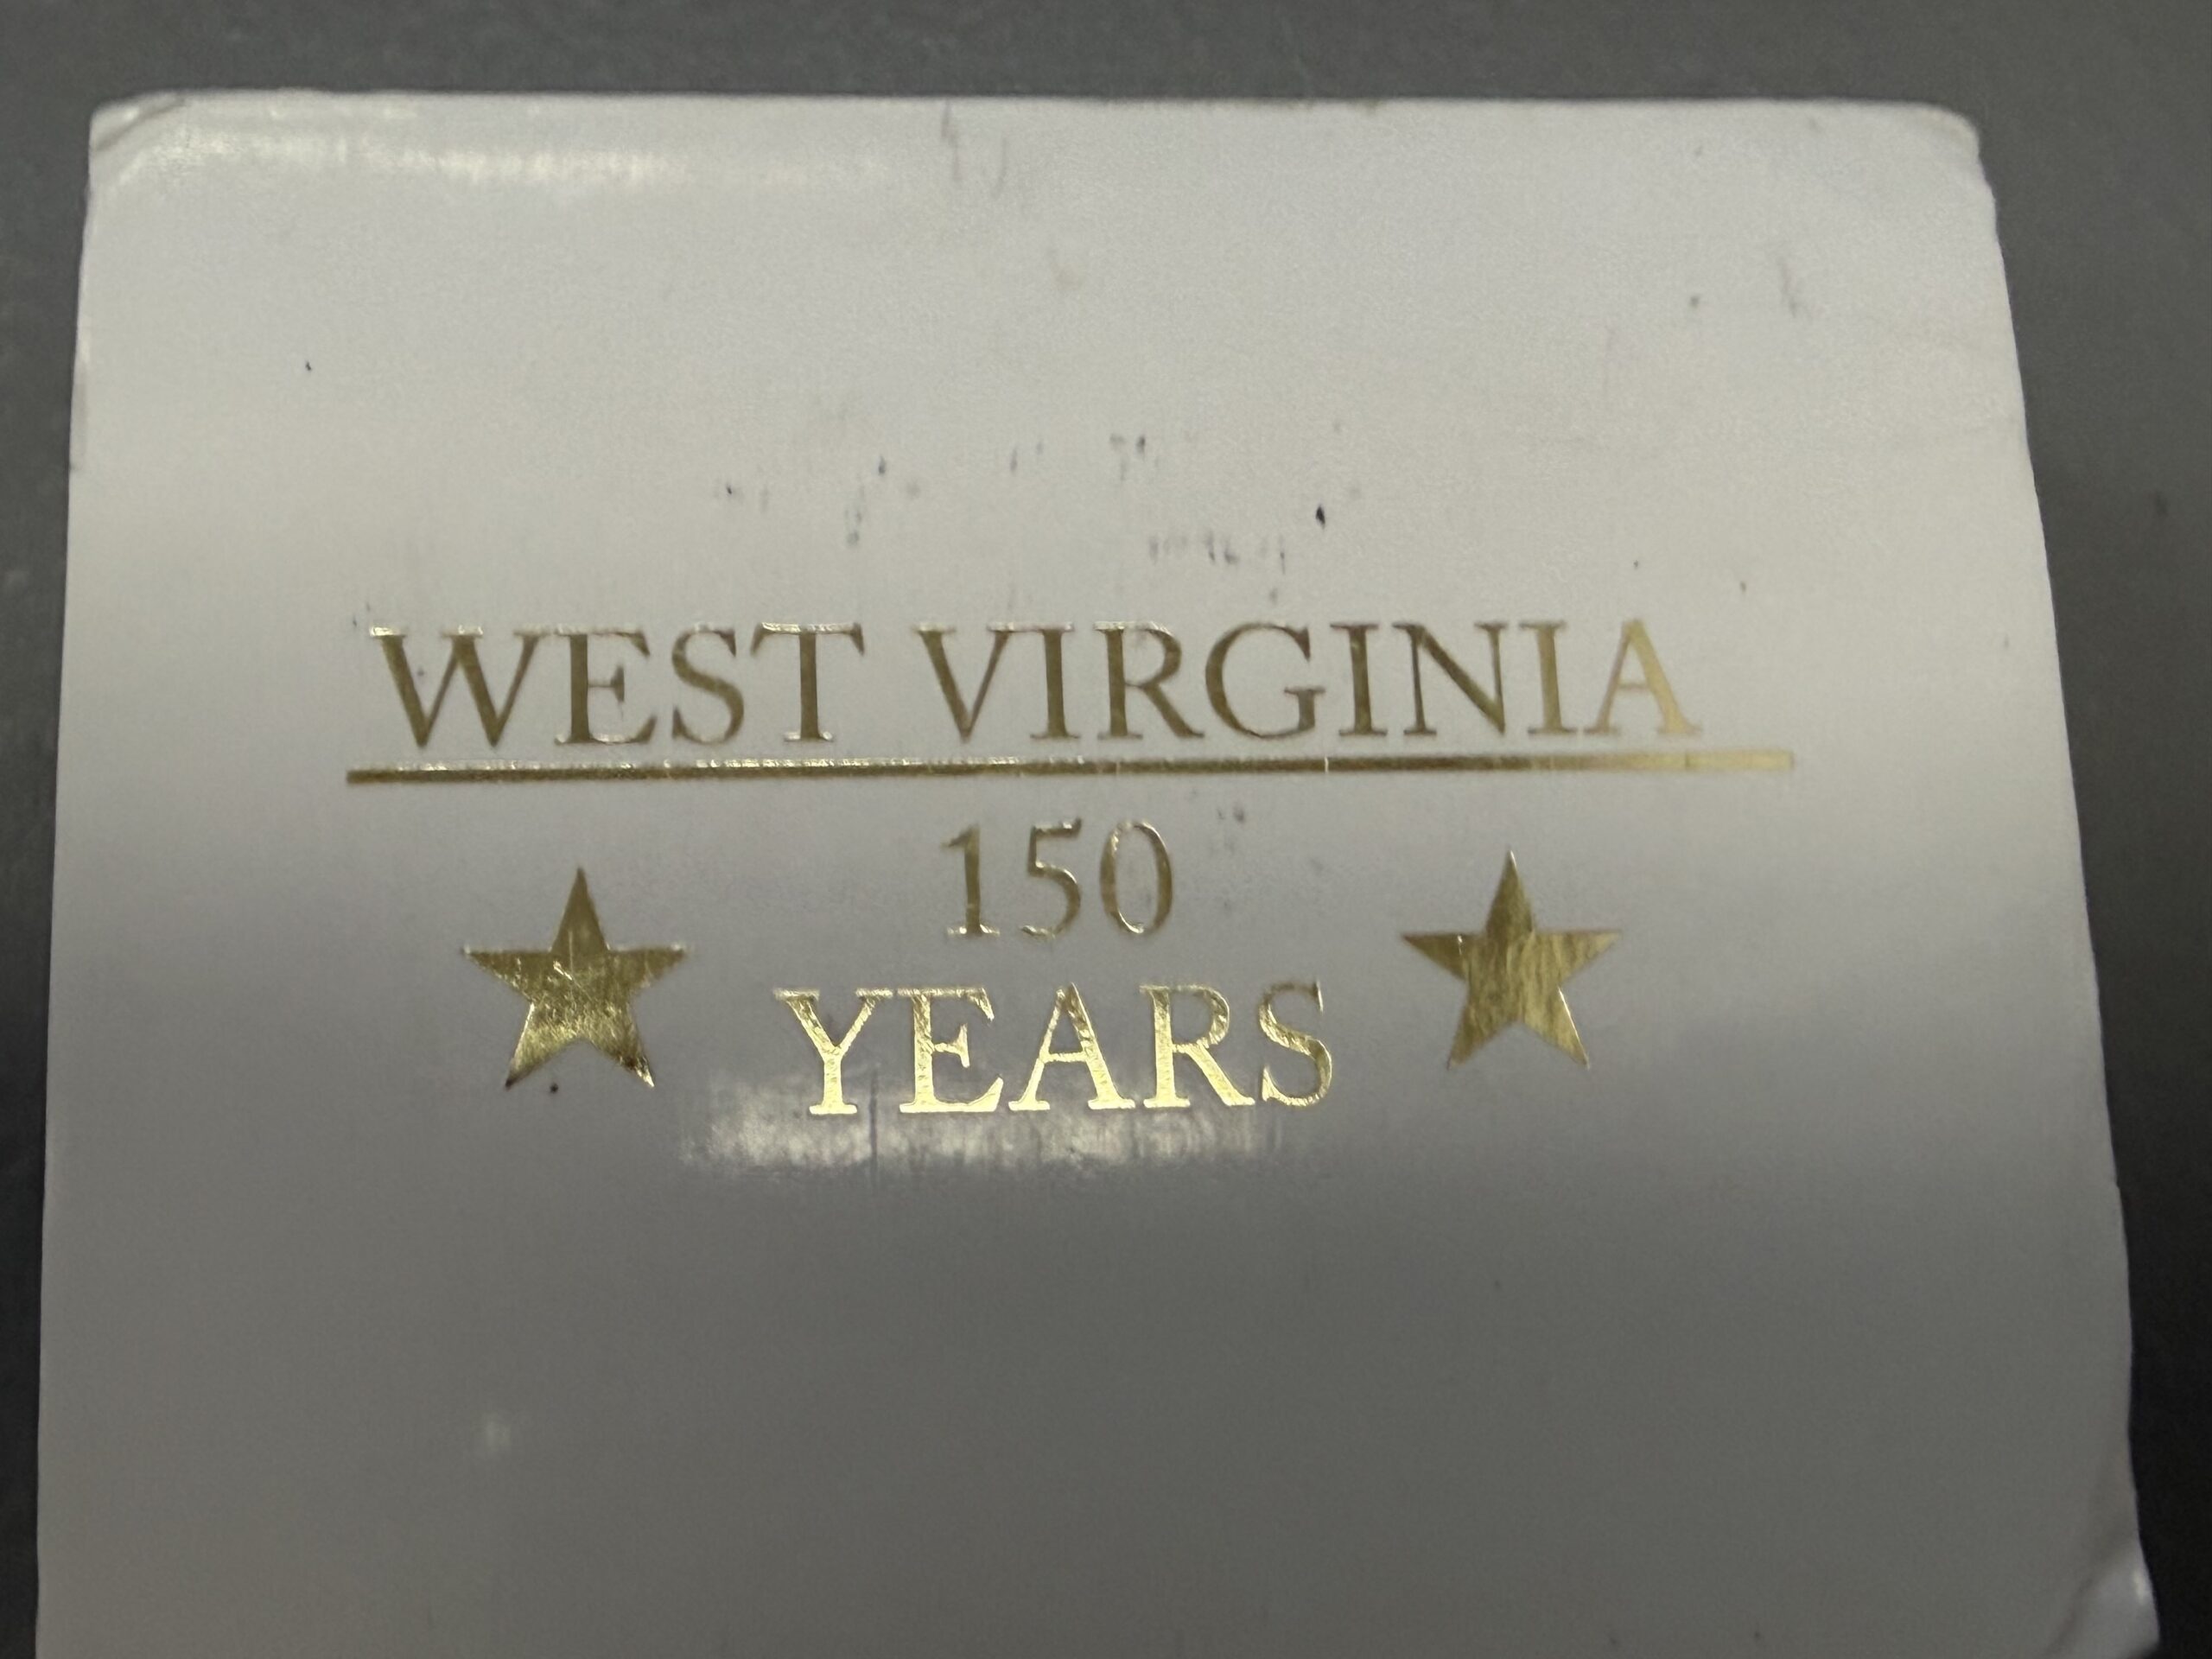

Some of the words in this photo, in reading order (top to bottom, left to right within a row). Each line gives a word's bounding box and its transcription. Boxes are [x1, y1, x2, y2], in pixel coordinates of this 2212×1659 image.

[369, 622, 865, 748] WEST
[912, 618, 1703, 743] VIRGINIA
[943, 819, 1173, 938] 150
[774, 981, 1334, 1117] YEARS
